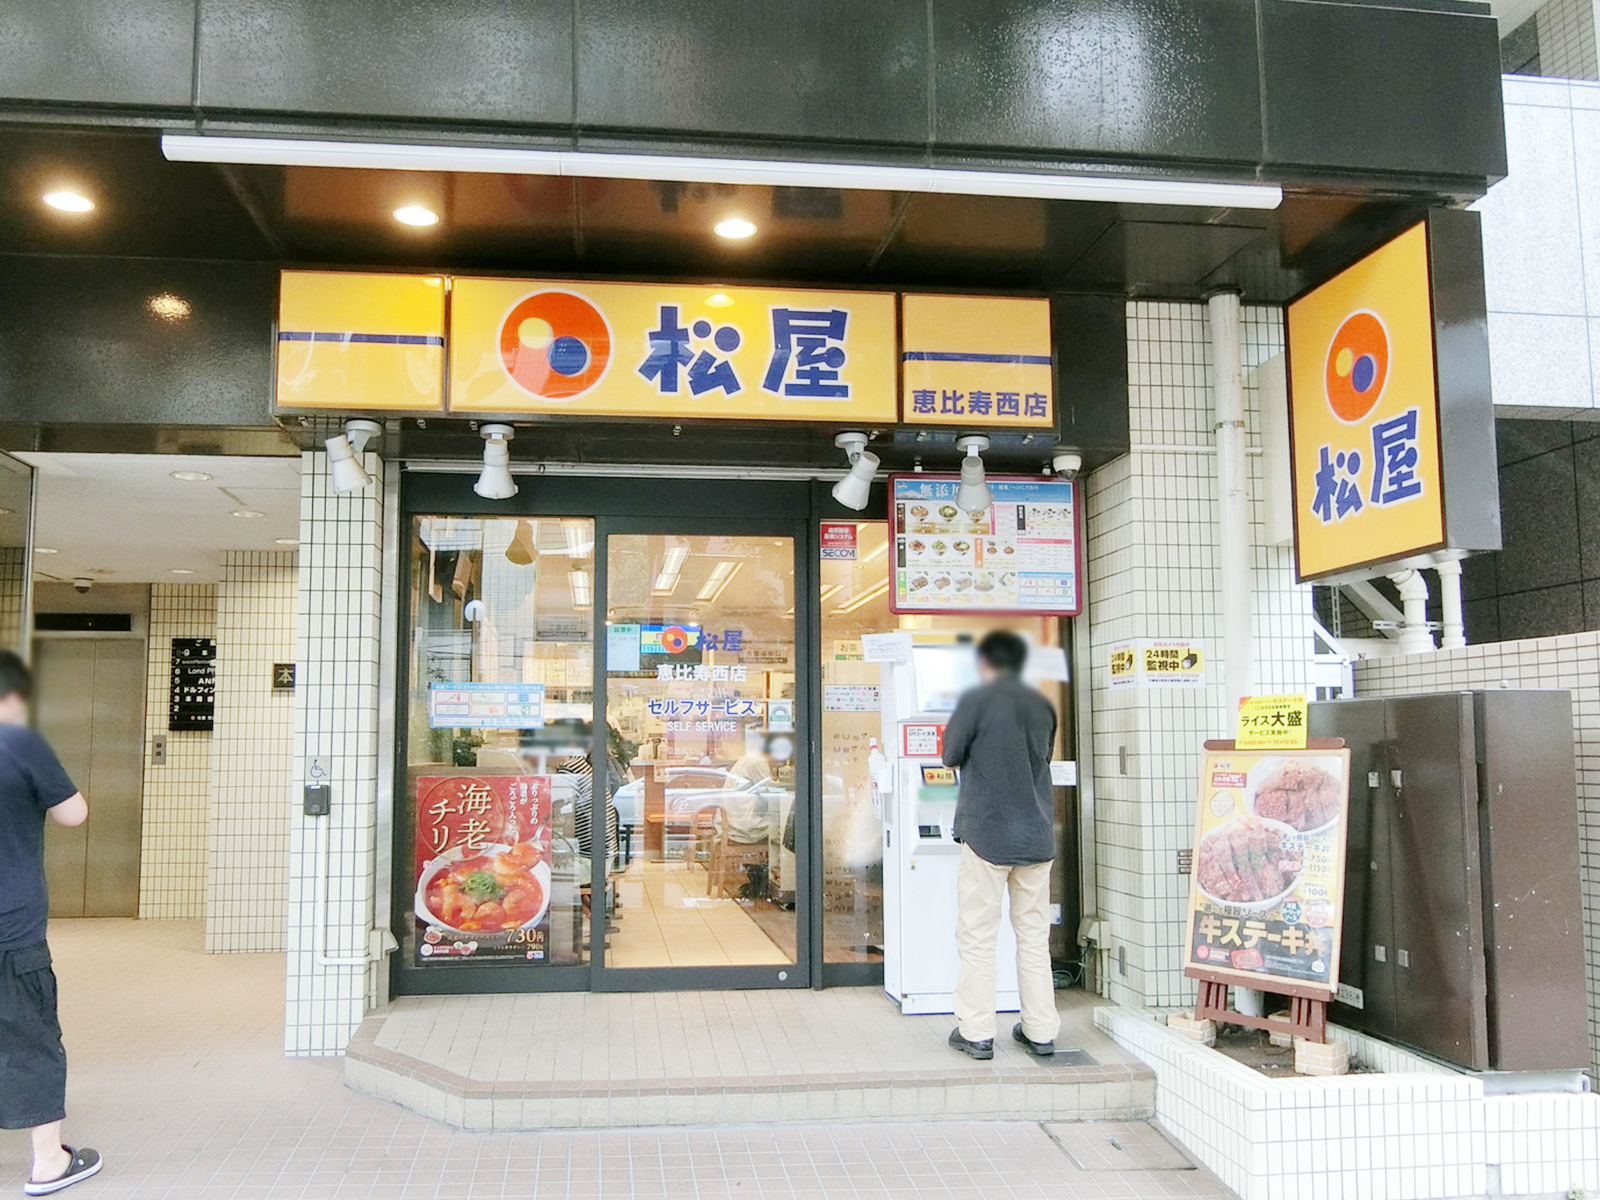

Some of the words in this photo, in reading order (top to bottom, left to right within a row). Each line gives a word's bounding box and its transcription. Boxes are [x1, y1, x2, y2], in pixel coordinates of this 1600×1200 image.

[637, 305, 850, 399] 松屋
[912, 389, 1047, 418] 恵比寿西店
[1311, 409, 1422, 523] 松屋
[822, 548, 856, 558] SECOM
[694, 630, 743, 652] 松屋
[1145, 649, 1179, 659] 24時間
[656, 664, 748, 683] 恵比寿西店
[1146, 660, 1179, 671] 監視中
[278, 667, 294, 684] 本
[647, 700, 757, 716] セルフサービス
[667, 721, 692, 733] SELF
[695, 721, 737, 733] SERVICE
[1241, 710, 1303, 727] ライス大盛
[428, 798, 456, 852] チリ
[457, 783, 492, 850] 海老
[1198, 914, 1327, 957] 牛ステーキ丼
